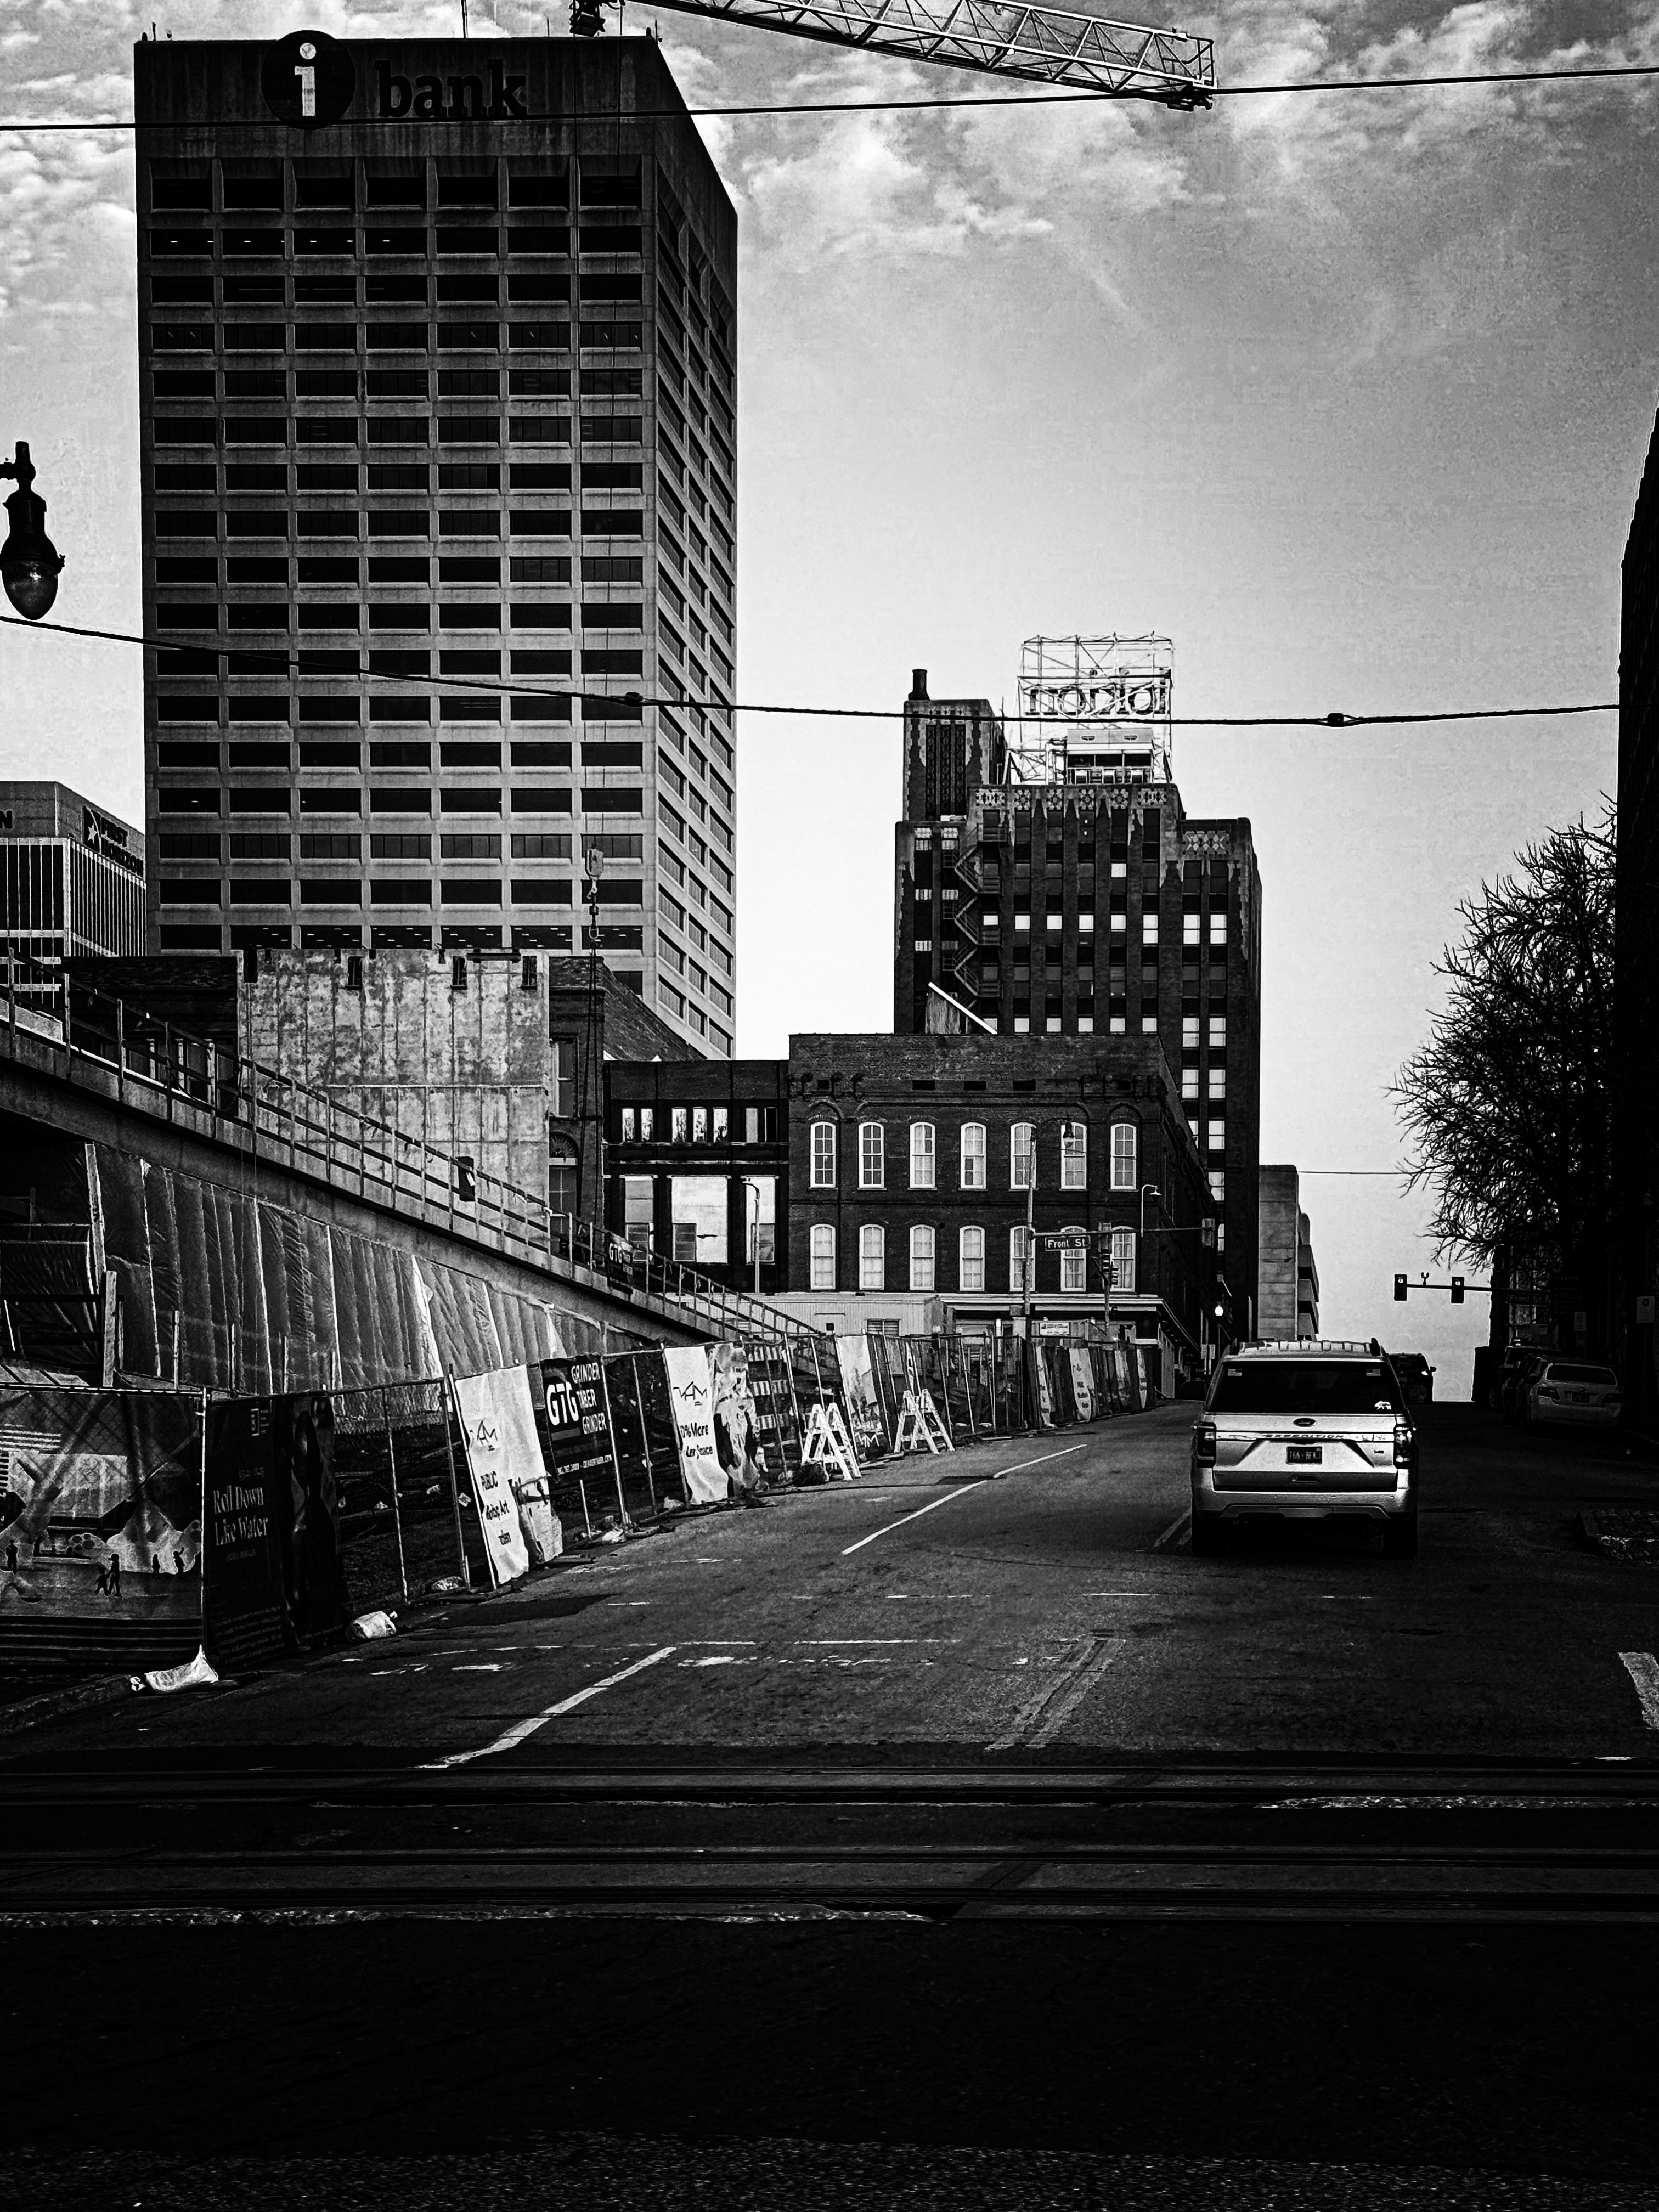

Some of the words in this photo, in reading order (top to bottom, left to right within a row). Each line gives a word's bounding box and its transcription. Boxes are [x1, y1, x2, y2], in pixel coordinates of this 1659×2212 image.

[375, 59, 527, 117] bank
[101, 817, 128, 848] FIRST
[101, 837, 143, 878] HORIZON
[1047, 1239, 1070, 1249] Front
[1075, 1238, 1086, 1248] St
[571, 1362, 601, 1384] GRINDER
[546, 1381, 579, 1426] GTG
[213, 1484, 233, 1514] Roll
[234, 1486, 265, 1510] Down
[214, 1518, 236, 1547] Like
[237, 1515, 269, 1541] Water
